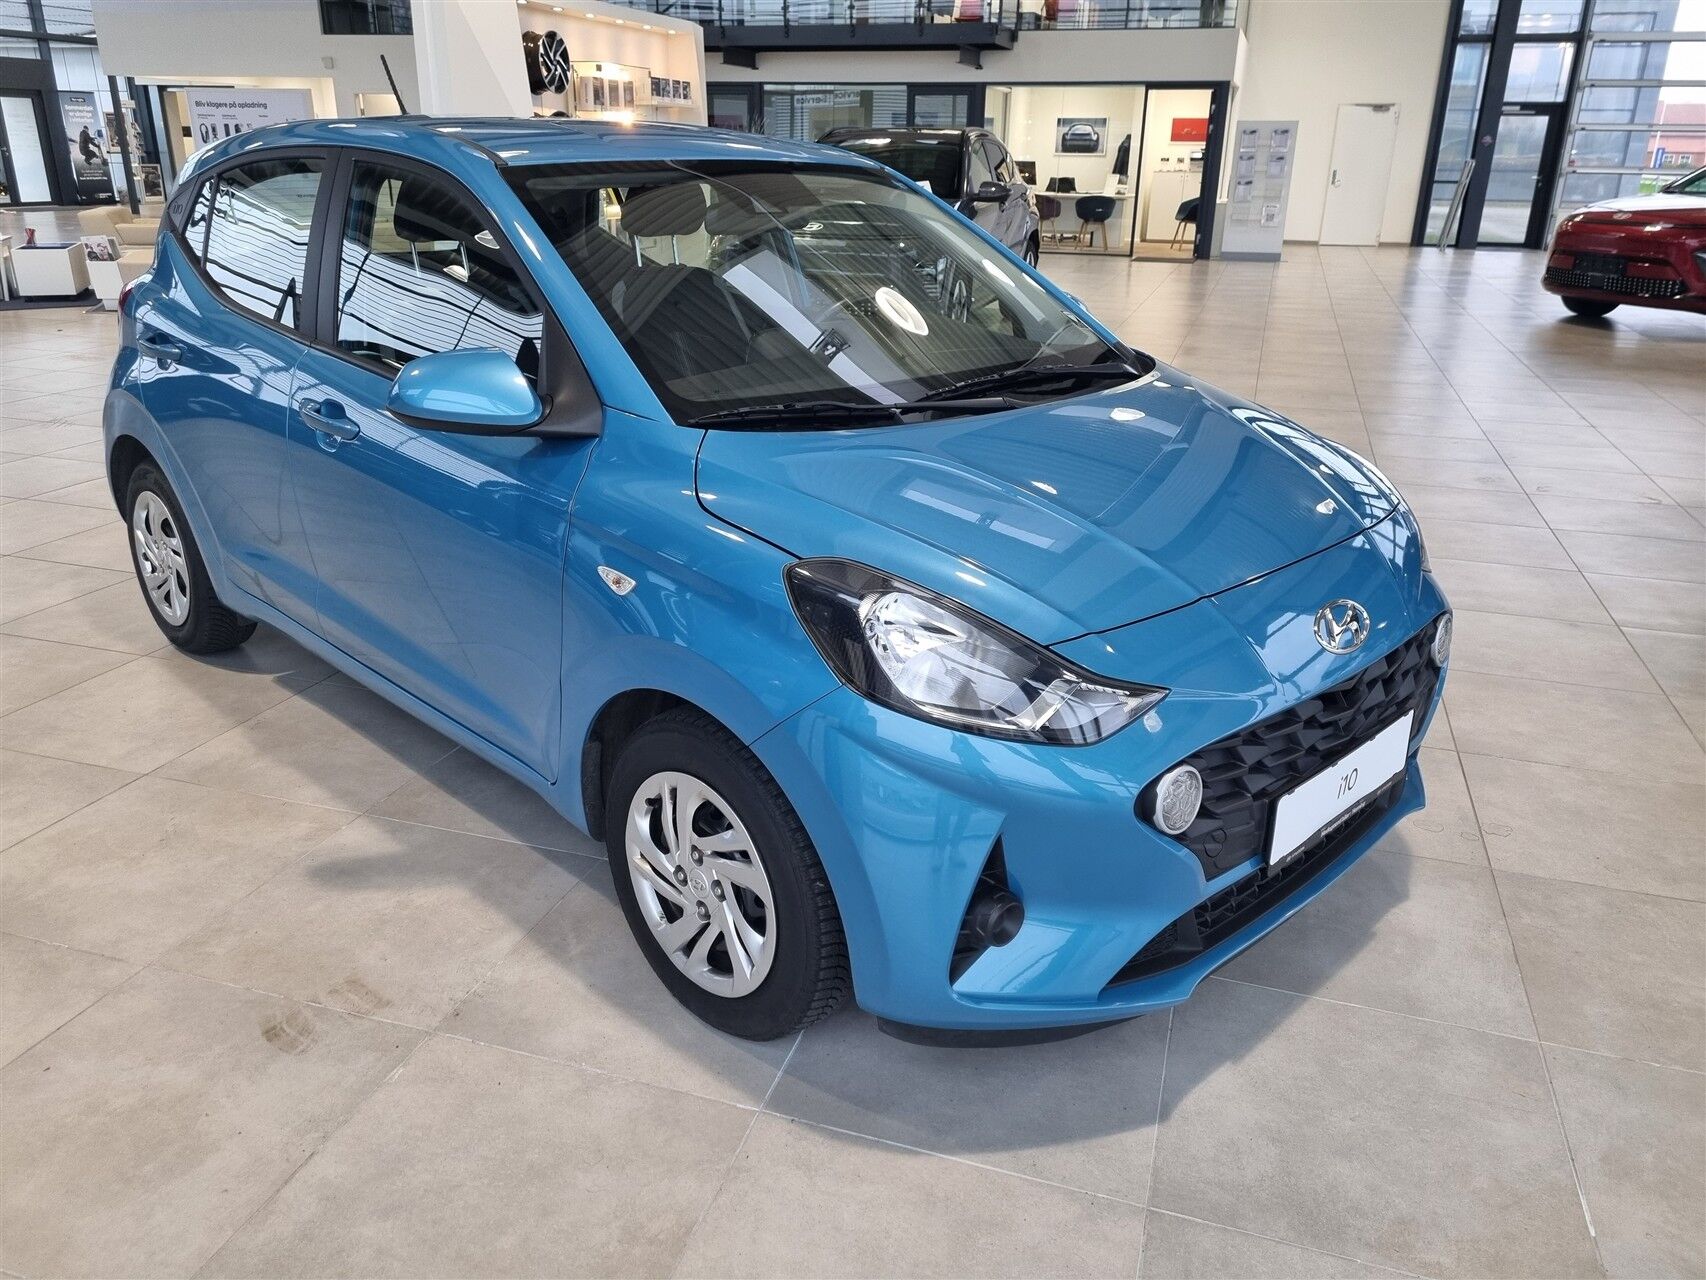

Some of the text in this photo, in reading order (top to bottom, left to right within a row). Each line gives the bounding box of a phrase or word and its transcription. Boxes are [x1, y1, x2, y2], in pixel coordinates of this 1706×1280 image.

[229, 101, 237, 109] på
[238, 101, 268, 110] opladning
[1337, 768, 1358, 799] i10
